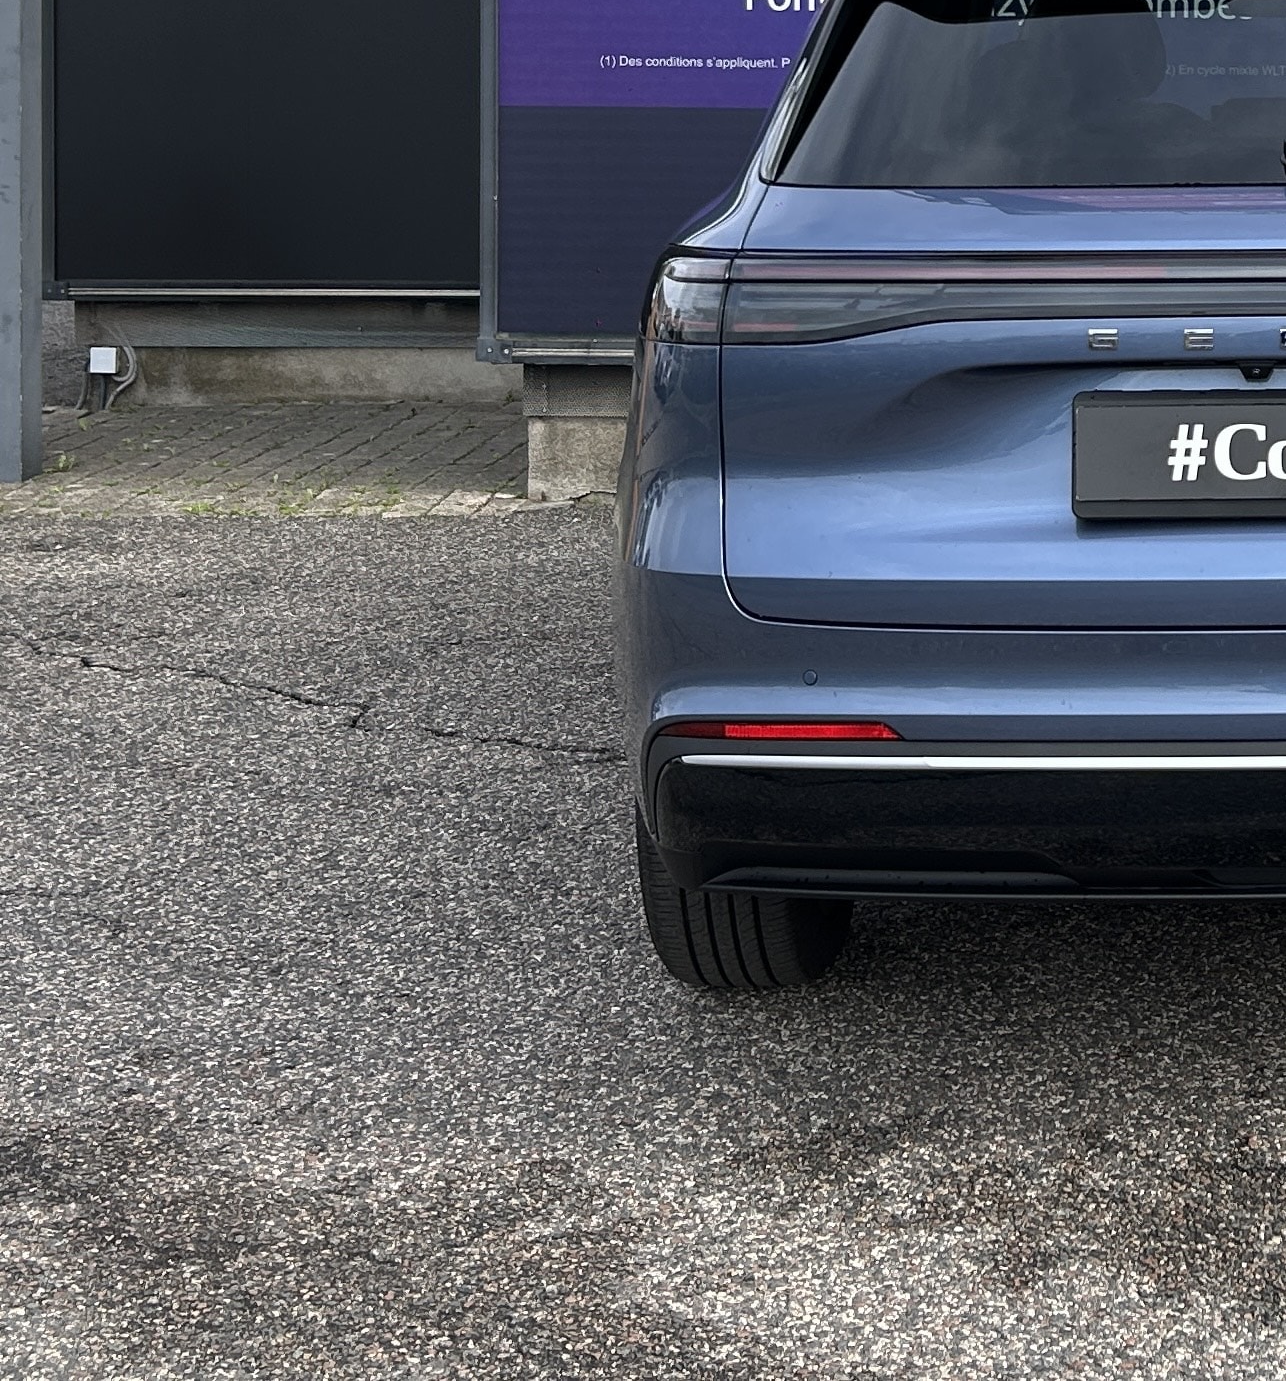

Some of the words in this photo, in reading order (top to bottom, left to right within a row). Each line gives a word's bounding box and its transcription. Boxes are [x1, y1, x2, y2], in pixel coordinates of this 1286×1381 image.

[600, 55, 616, 68] (1)
[619, 55, 643, 67] Des
[645, 55, 704, 68] conditions
